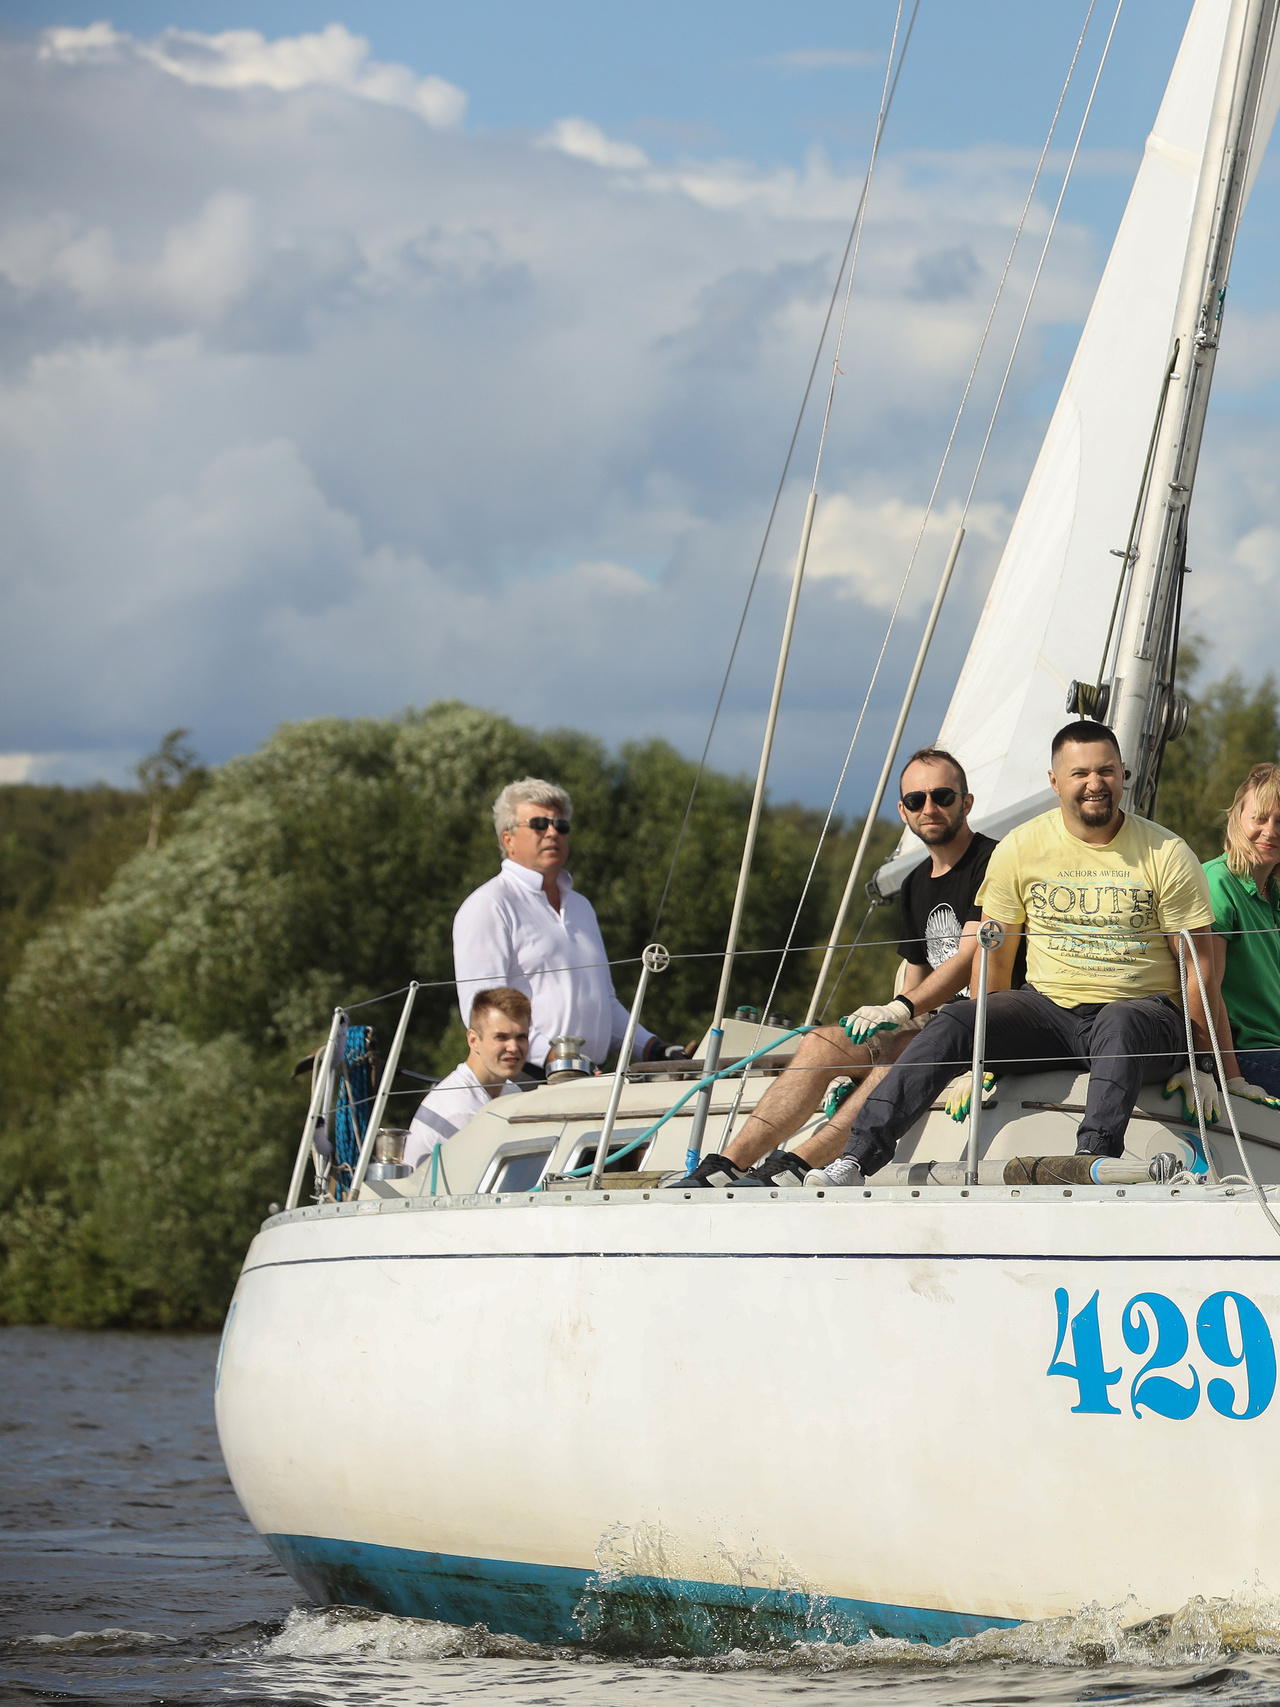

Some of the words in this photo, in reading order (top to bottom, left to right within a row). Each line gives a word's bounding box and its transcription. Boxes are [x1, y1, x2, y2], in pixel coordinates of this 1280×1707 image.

[1057, 870, 1097, 878] ANCHORS
[1099, 870, 1130, 878] AWEIGH
[1030, 882, 1154, 915] SOUTH
[1129, 911, 1154, 929] OF
[1046, 1287, 1278, 1420] 429
